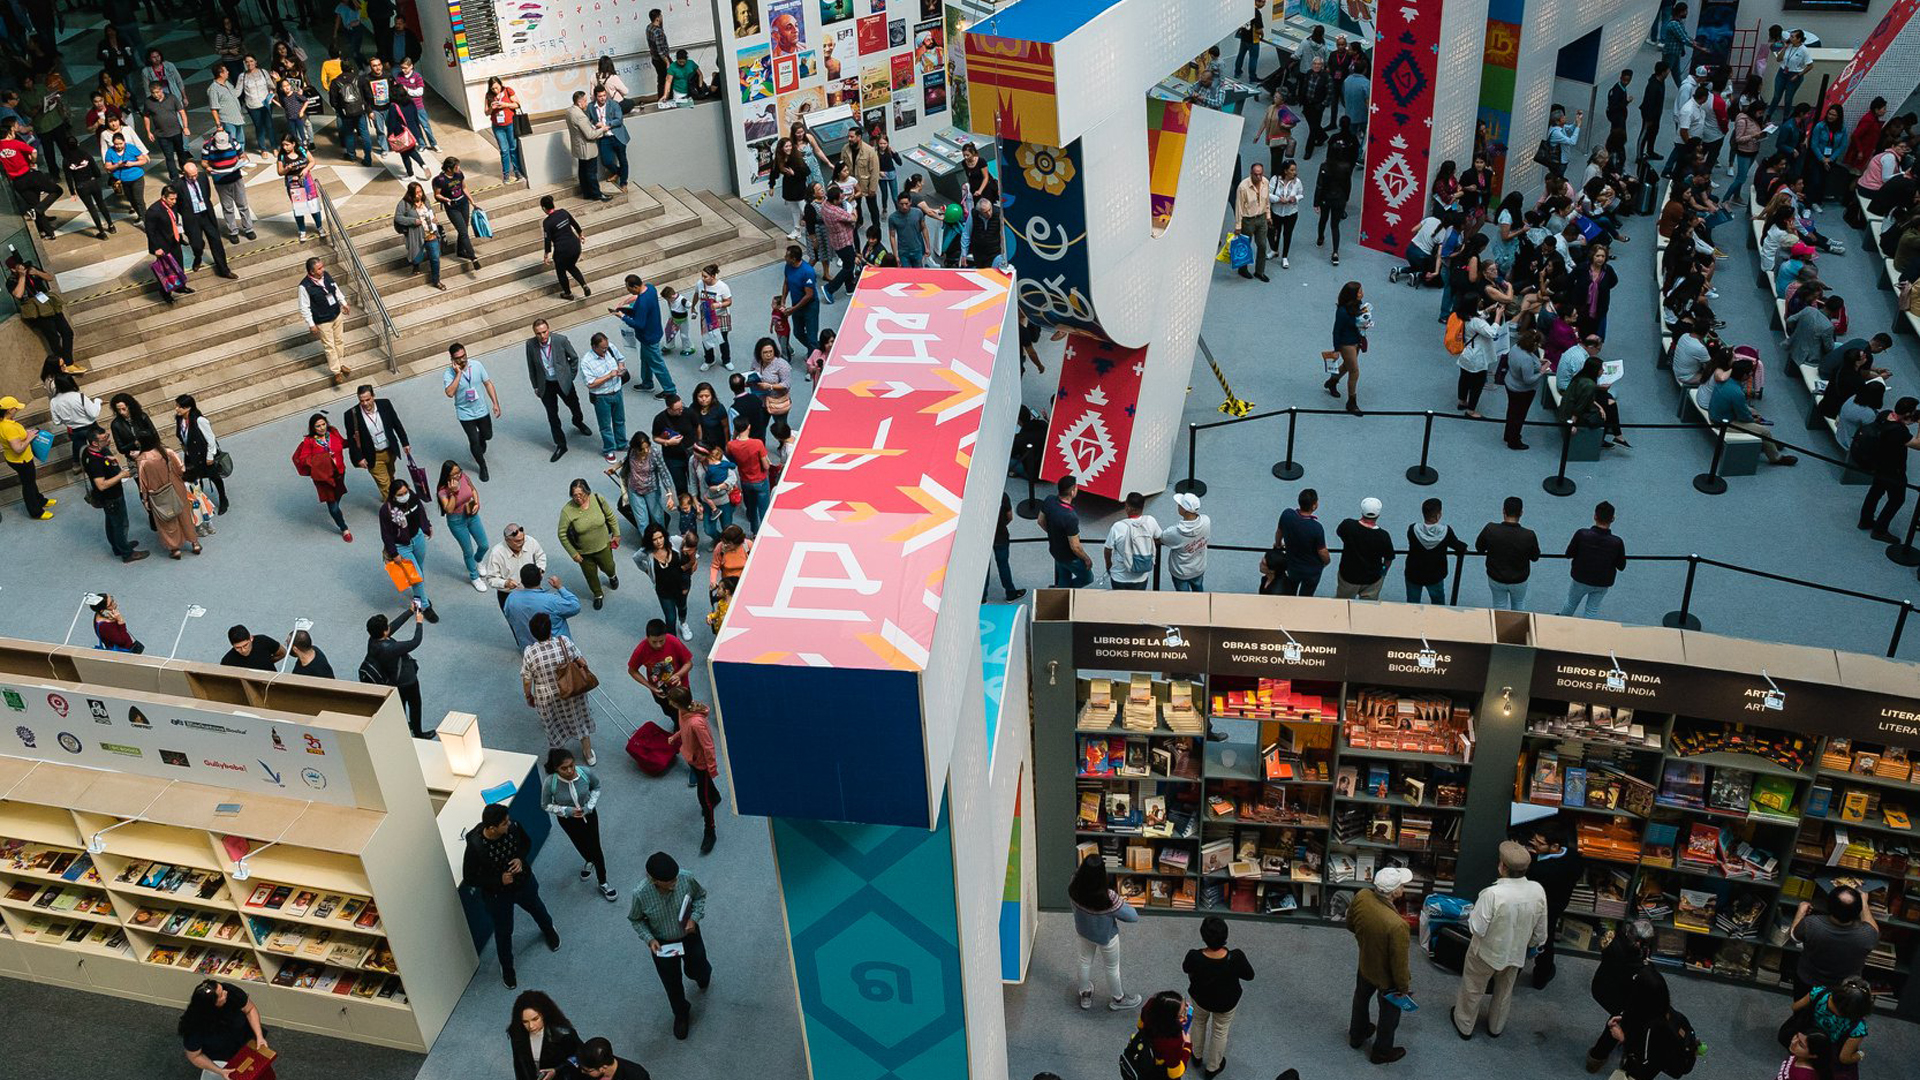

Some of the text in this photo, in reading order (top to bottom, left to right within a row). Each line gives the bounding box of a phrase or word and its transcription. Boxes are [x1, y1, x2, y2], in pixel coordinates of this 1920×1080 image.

[1093, 636, 1130, 645] LIBROS
[1132, 637, 1146, 646] DE
[1147, 638, 1161, 646] LA
[1222, 641, 1258, 650] OBRAS
[1095, 649, 1188, 660] BOOKS FROM INDIA
[1231, 654, 1269, 664] WORKS
[1270, 656, 1285, 664] ON
[1388, 663, 1448, 676] BIOGRAPHY
[1556, 665, 1597, 676] LIBROS
[1630, 673, 1662, 685] INDIA
[1556, 678, 1594, 690] BOOKS
[1627, 686, 1657, 697] INDIA
